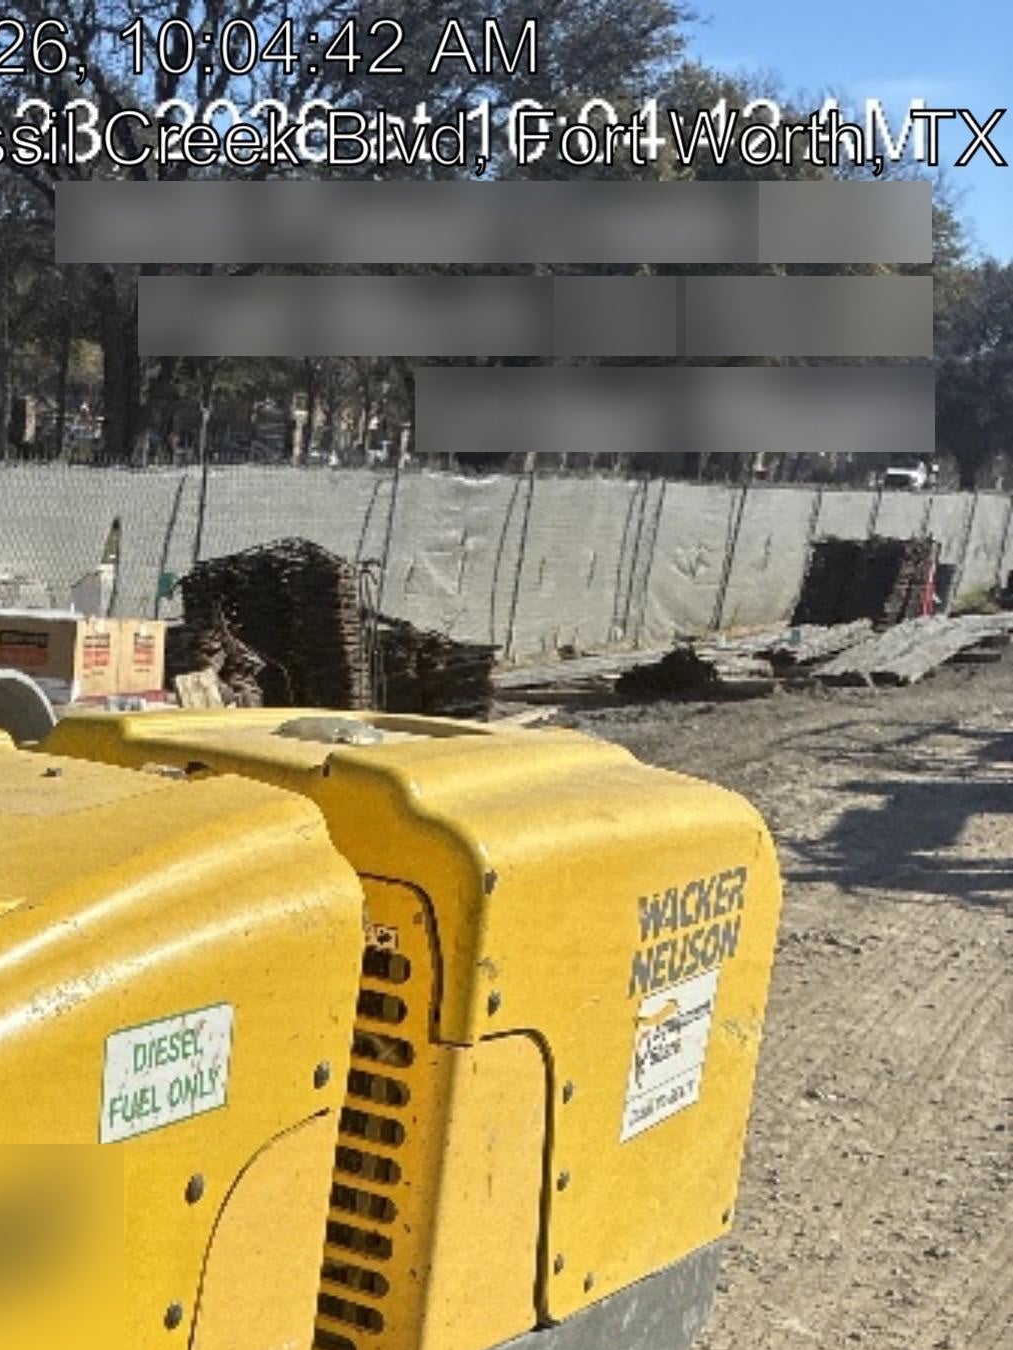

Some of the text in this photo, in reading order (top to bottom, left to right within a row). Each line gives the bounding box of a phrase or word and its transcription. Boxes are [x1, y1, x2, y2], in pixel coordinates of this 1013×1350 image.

[638, 866, 747, 943] WACKER
[628, 915, 740, 999] NEUSON
[134, 1028, 203, 1075] DIESEL
[109, 1064, 221, 1128] FUEL ONLY
